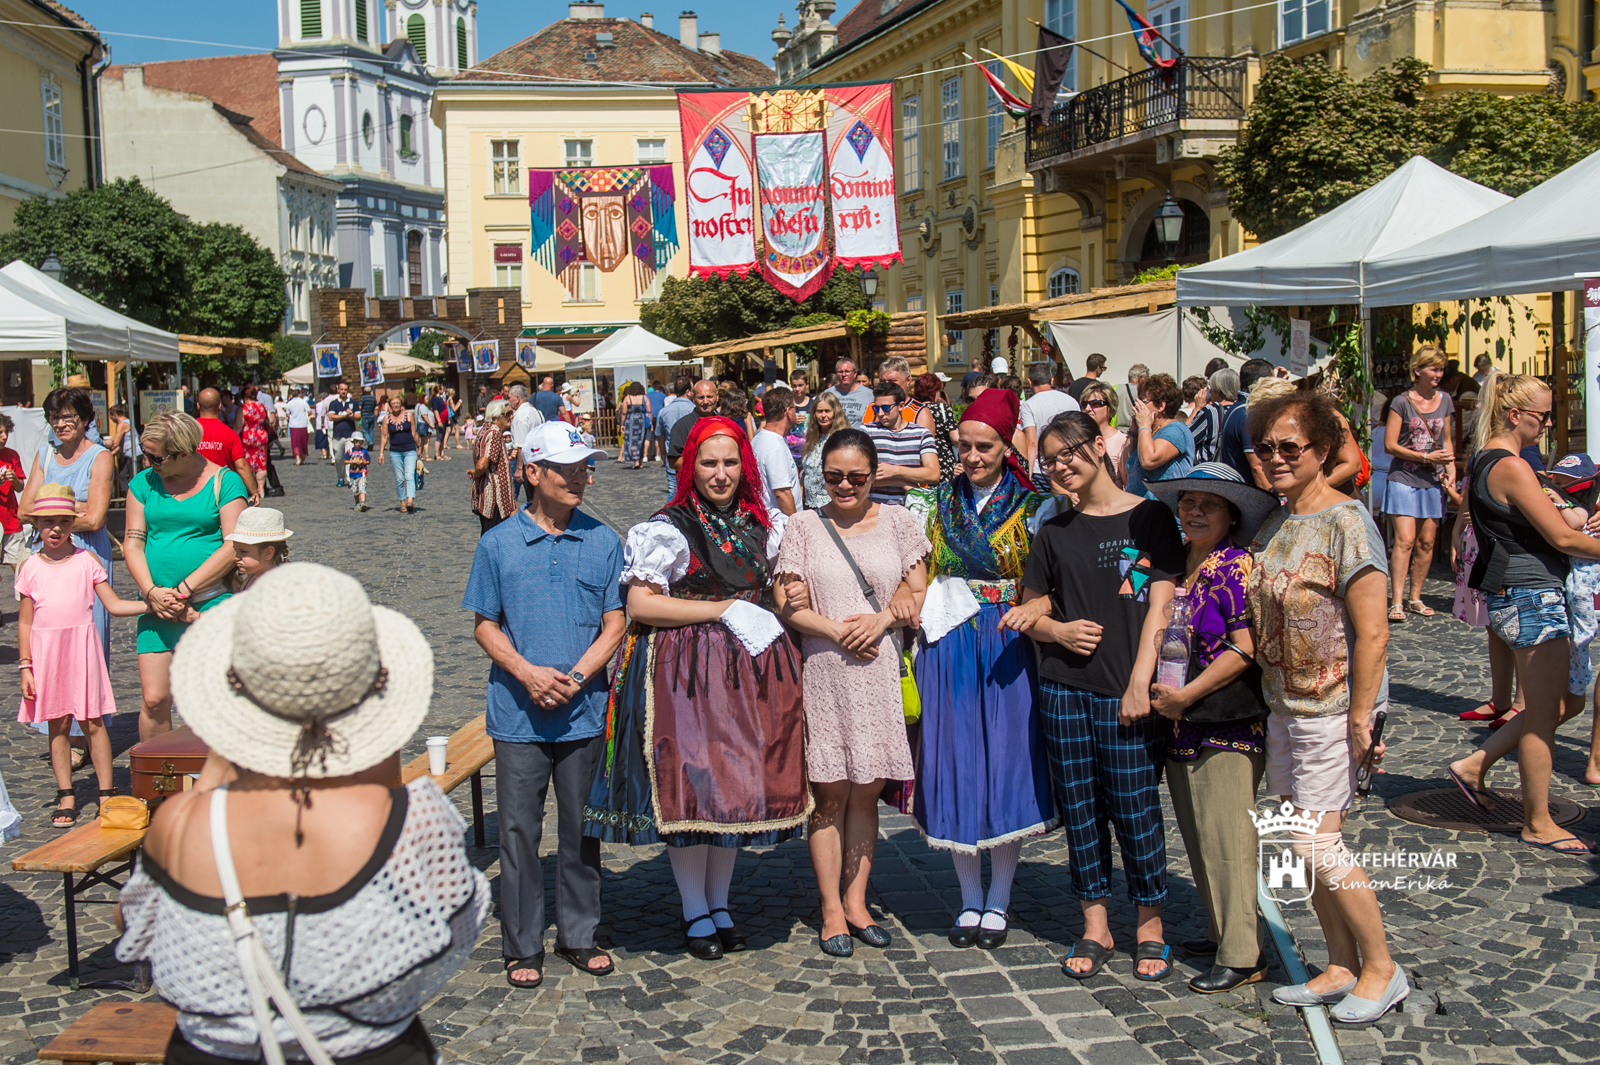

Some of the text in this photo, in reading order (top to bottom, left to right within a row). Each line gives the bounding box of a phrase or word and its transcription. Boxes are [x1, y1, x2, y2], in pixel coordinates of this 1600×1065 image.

[688, 166, 751, 216] In
[830, 170, 895, 200] domini
[1099, 538, 1136, 549] GRAINY
